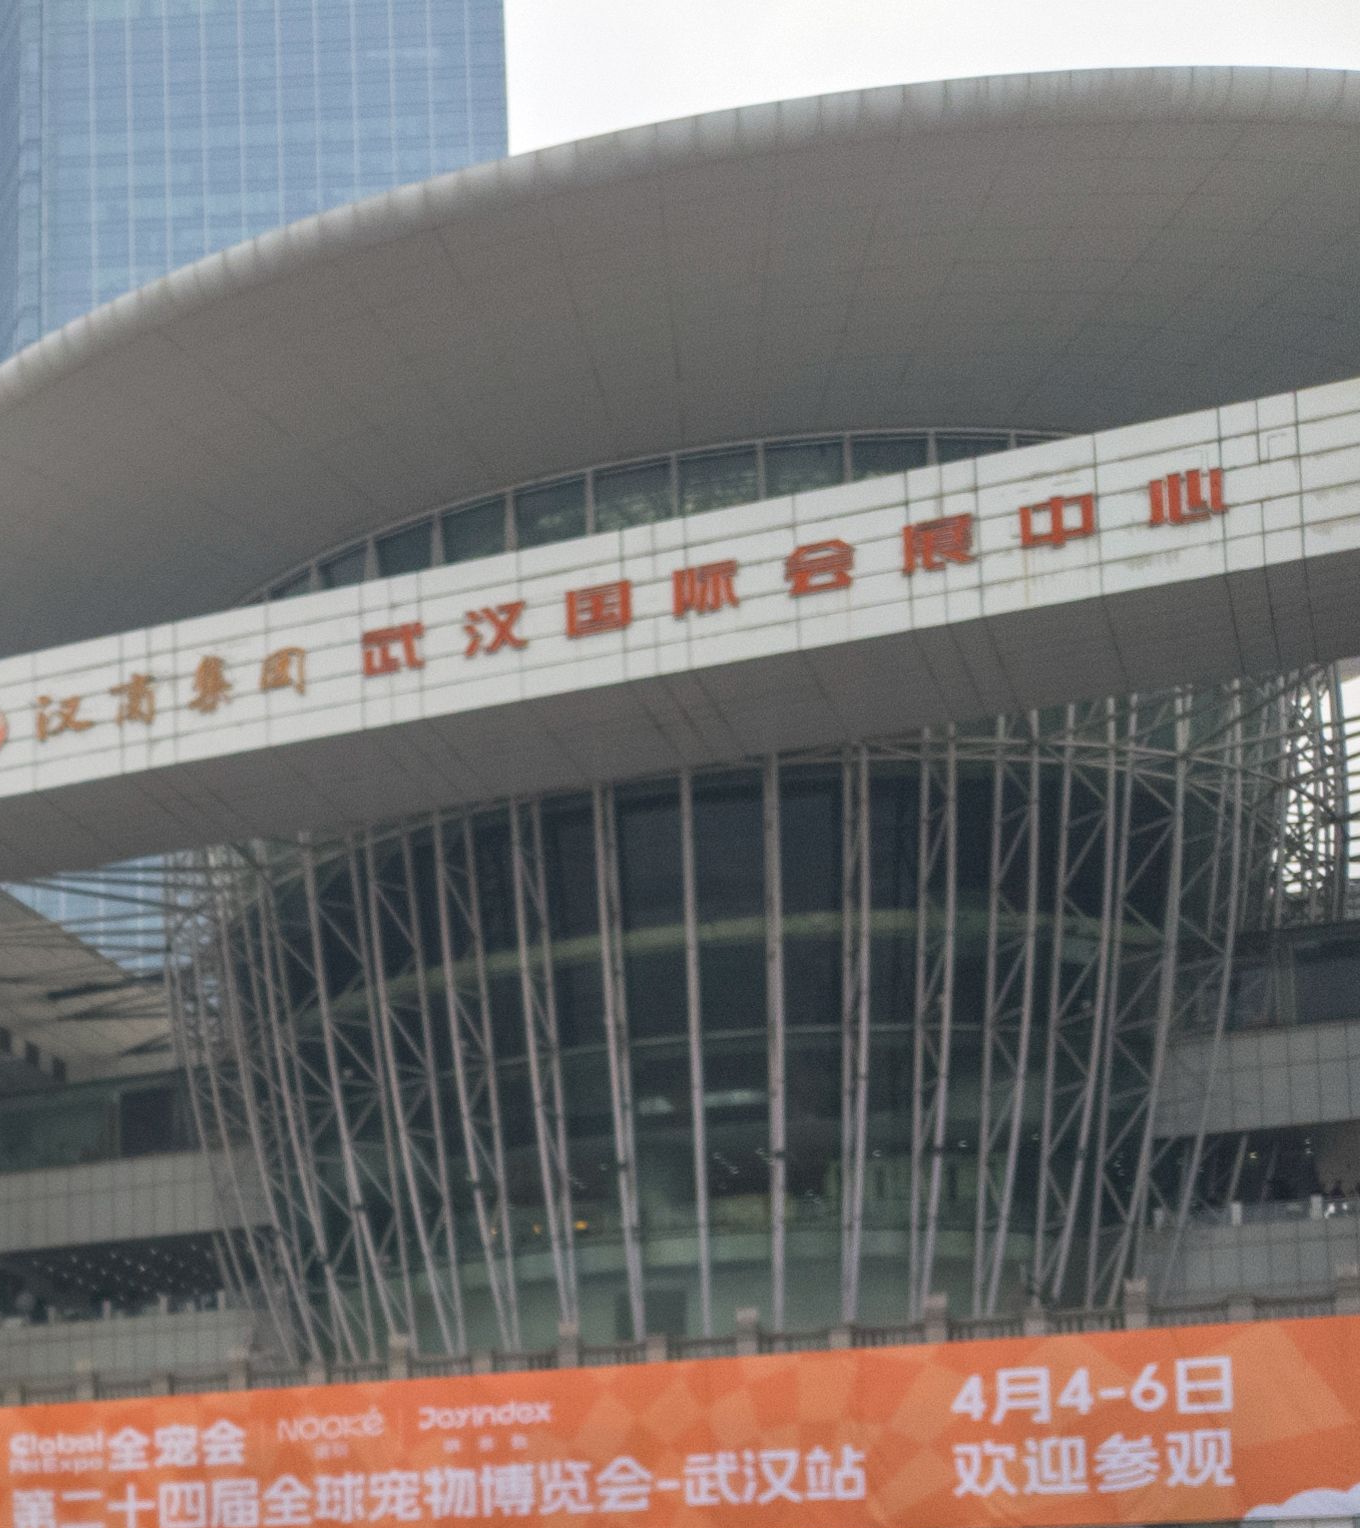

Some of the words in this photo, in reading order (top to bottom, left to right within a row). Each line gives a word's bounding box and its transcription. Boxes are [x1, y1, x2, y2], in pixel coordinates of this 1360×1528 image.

[34, 645, 308, 743] 汉商集团
[360, 465, 1230, 678] 武汉国际会展中心
[950, 1354, 1234, 1427] 4月4-6日
[108, 1418, 246, 1473] 全宠会
[950, 1427, 1236, 1498] 欢迎参观
